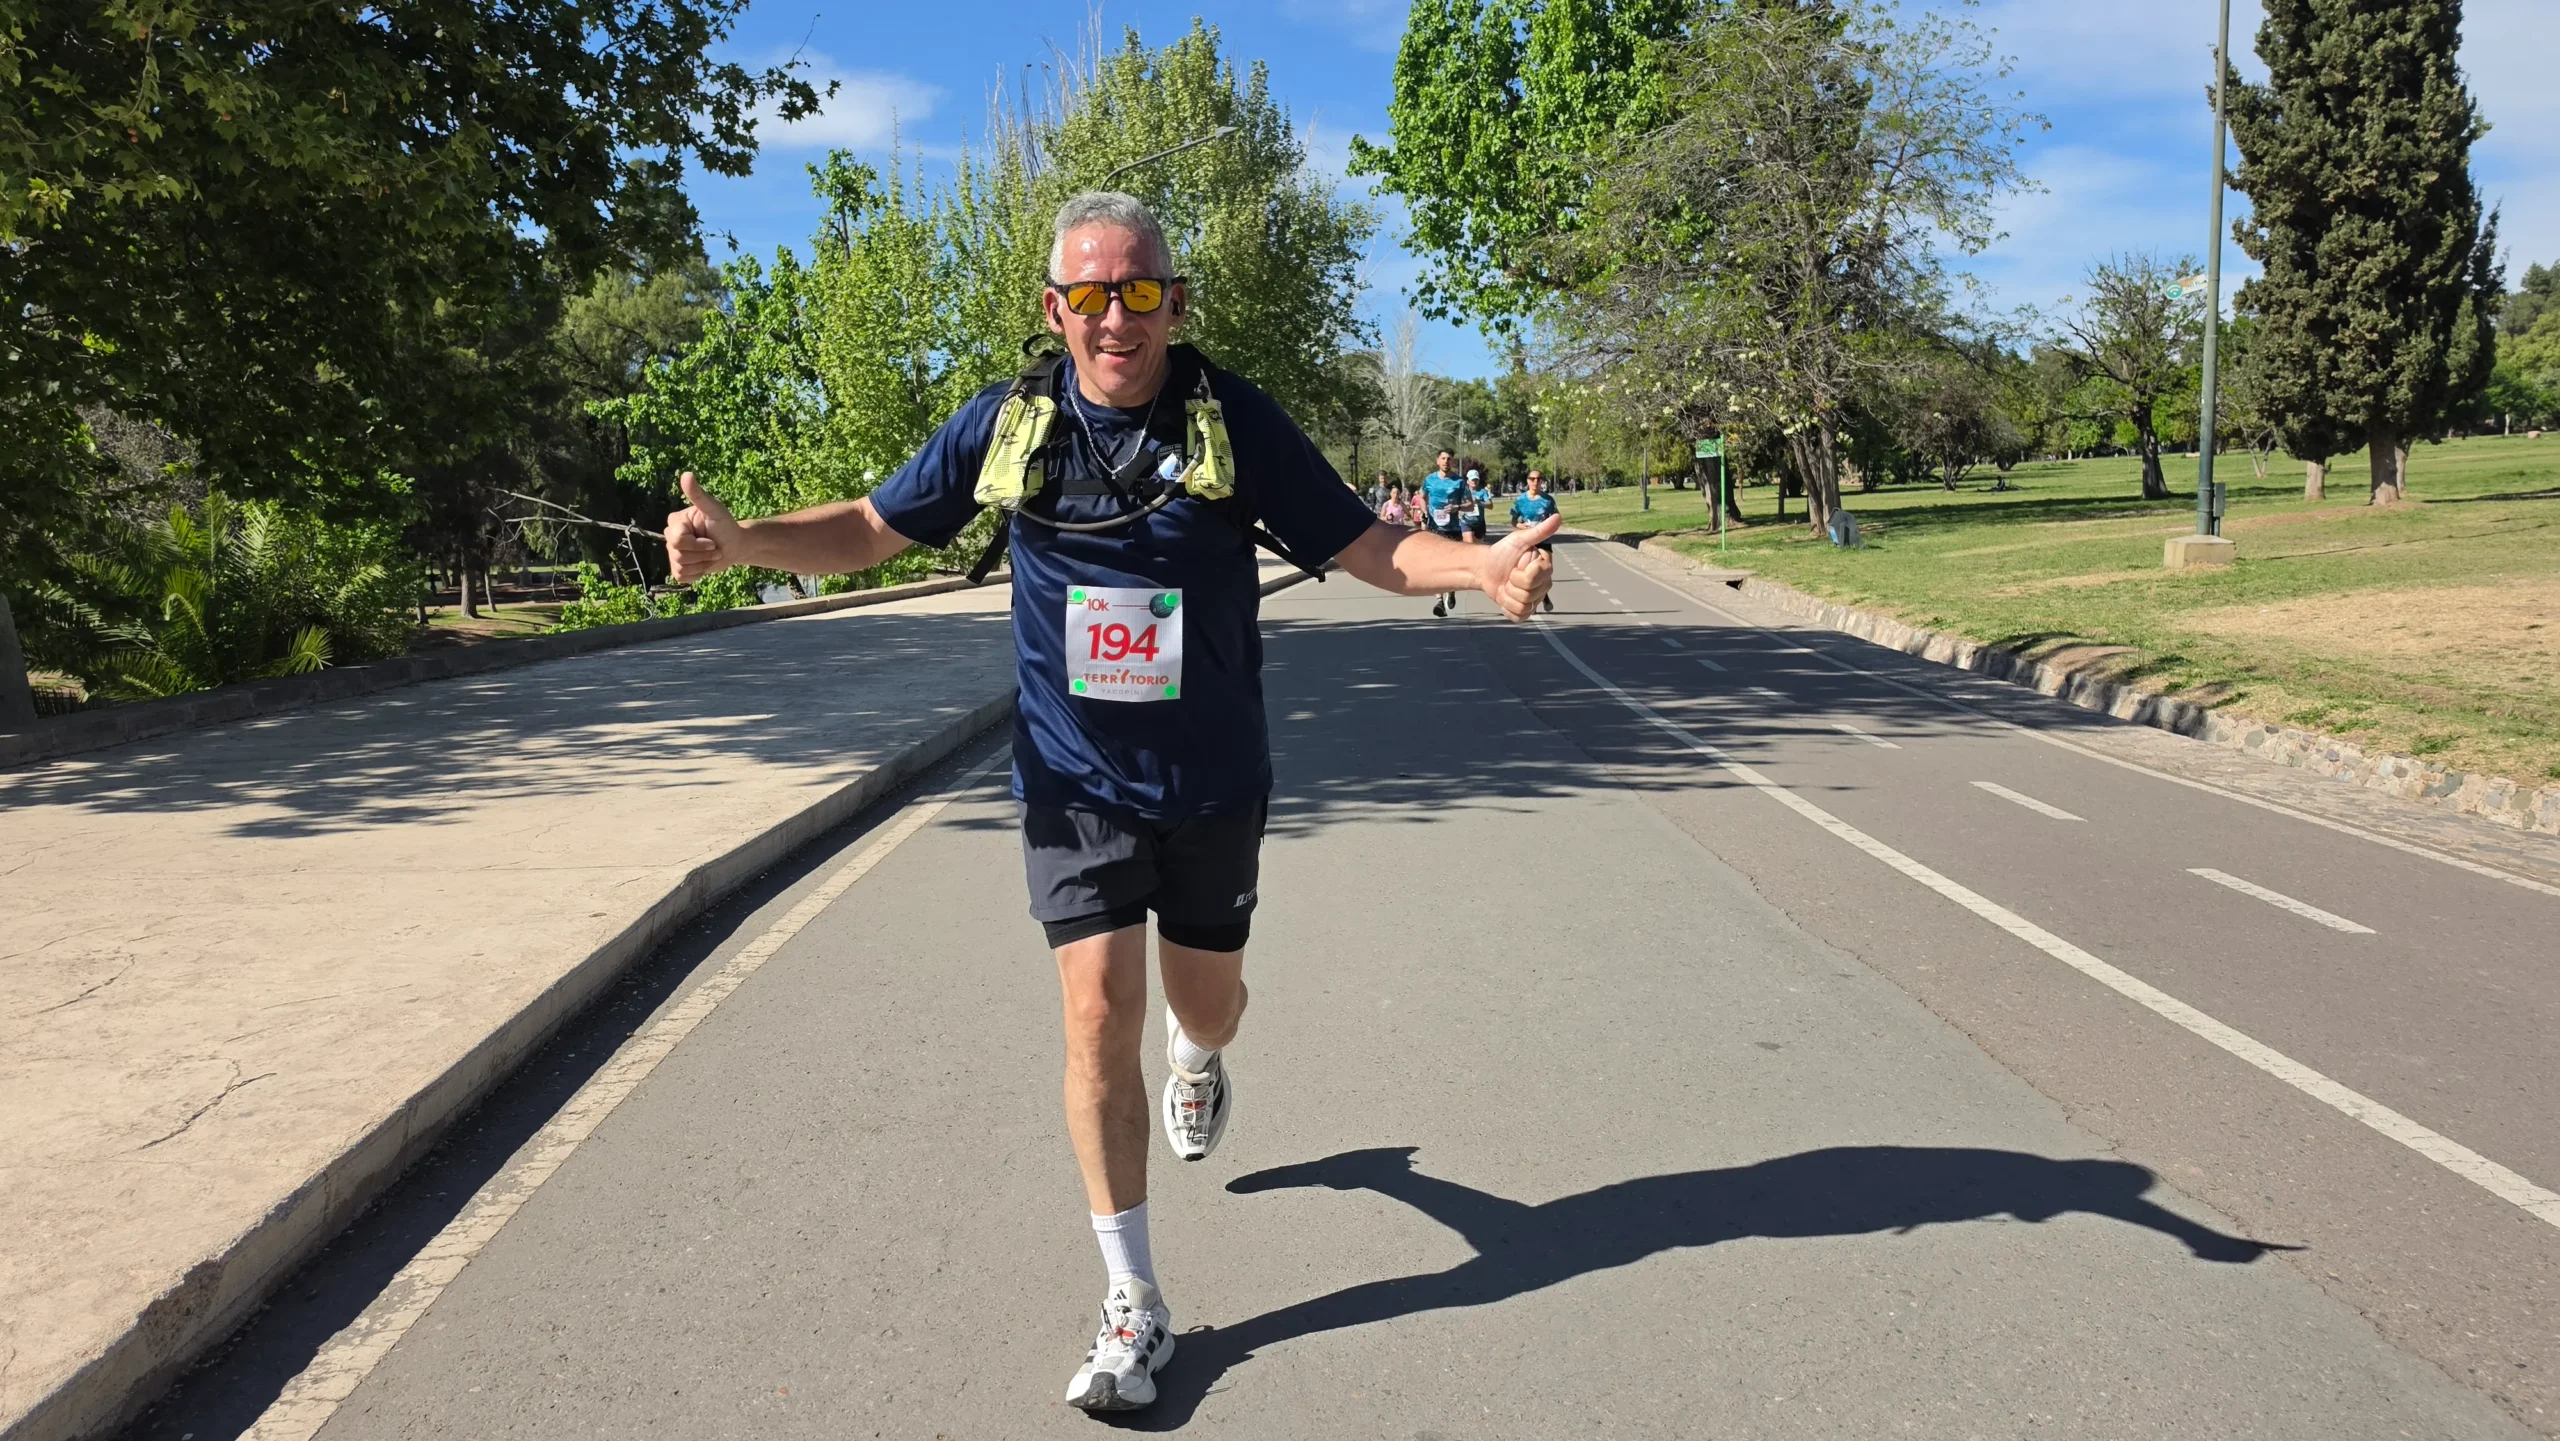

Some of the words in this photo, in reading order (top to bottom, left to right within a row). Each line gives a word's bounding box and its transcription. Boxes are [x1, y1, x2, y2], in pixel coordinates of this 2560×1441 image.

[1087, 598, 1109, 611] 10k
[1087, 623, 1160, 662] 194
[1084, 668, 1169, 685] TERRITORIO
